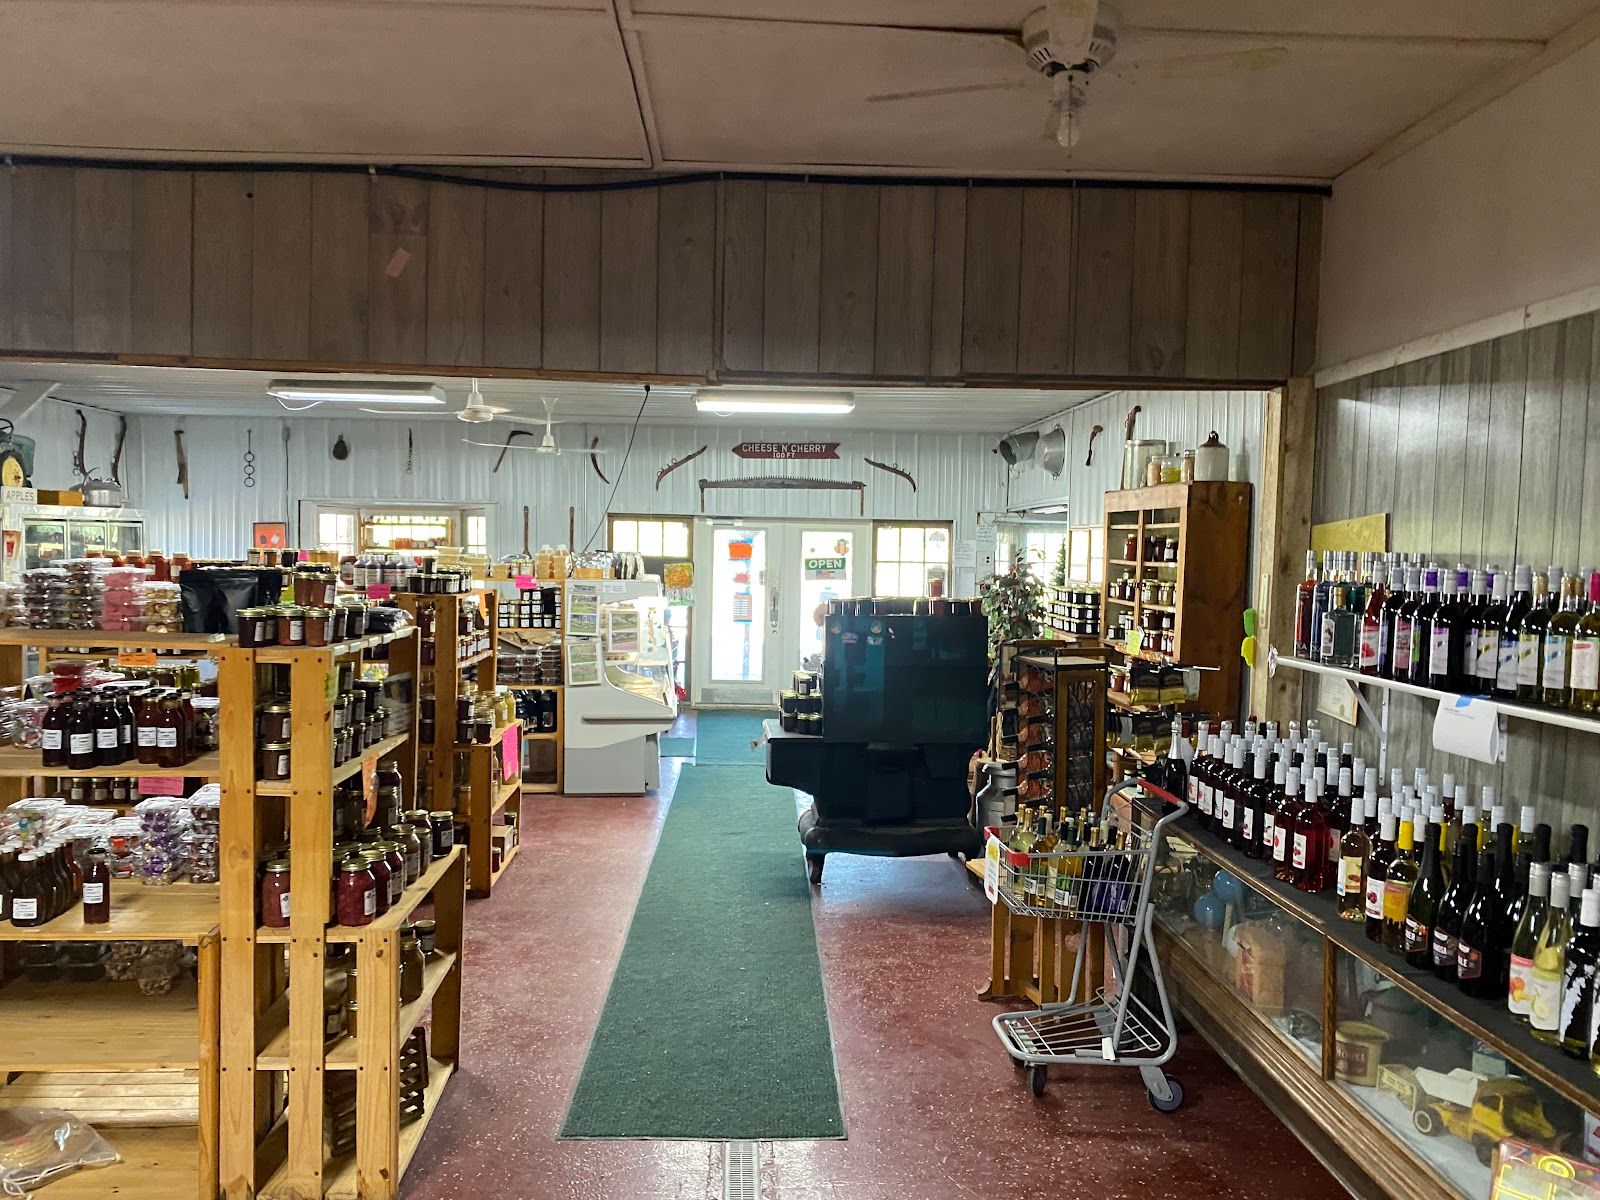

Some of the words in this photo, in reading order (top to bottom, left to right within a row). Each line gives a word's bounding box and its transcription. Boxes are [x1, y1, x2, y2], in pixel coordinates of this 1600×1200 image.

[791, 444, 826, 453] CHERRY
[6, 491, 34, 501] APPLES
[808, 559, 842, 569] OPEN
